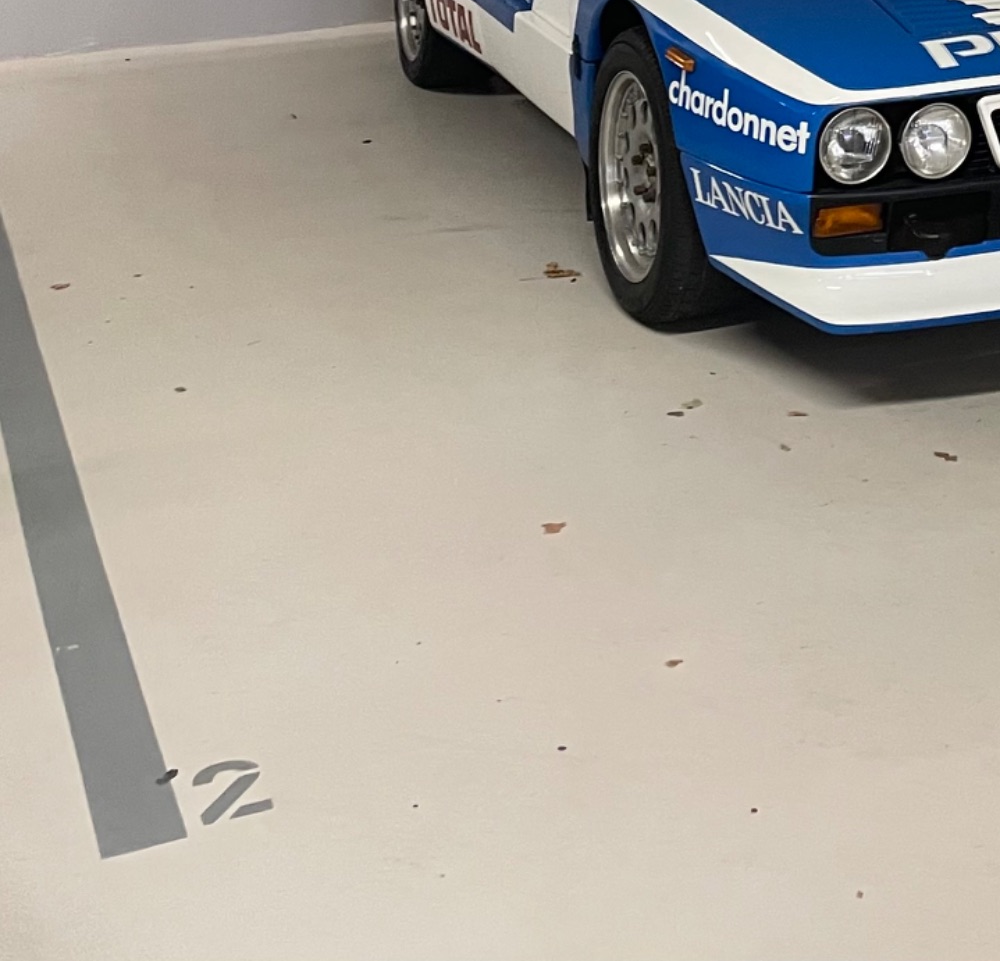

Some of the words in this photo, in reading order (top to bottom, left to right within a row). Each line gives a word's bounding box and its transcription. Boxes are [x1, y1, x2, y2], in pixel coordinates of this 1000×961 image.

[668, 69, 811, 155] chardonnet
[689, 167, 804, 235] LANCIA
[192, 759, 274, 826] 2
